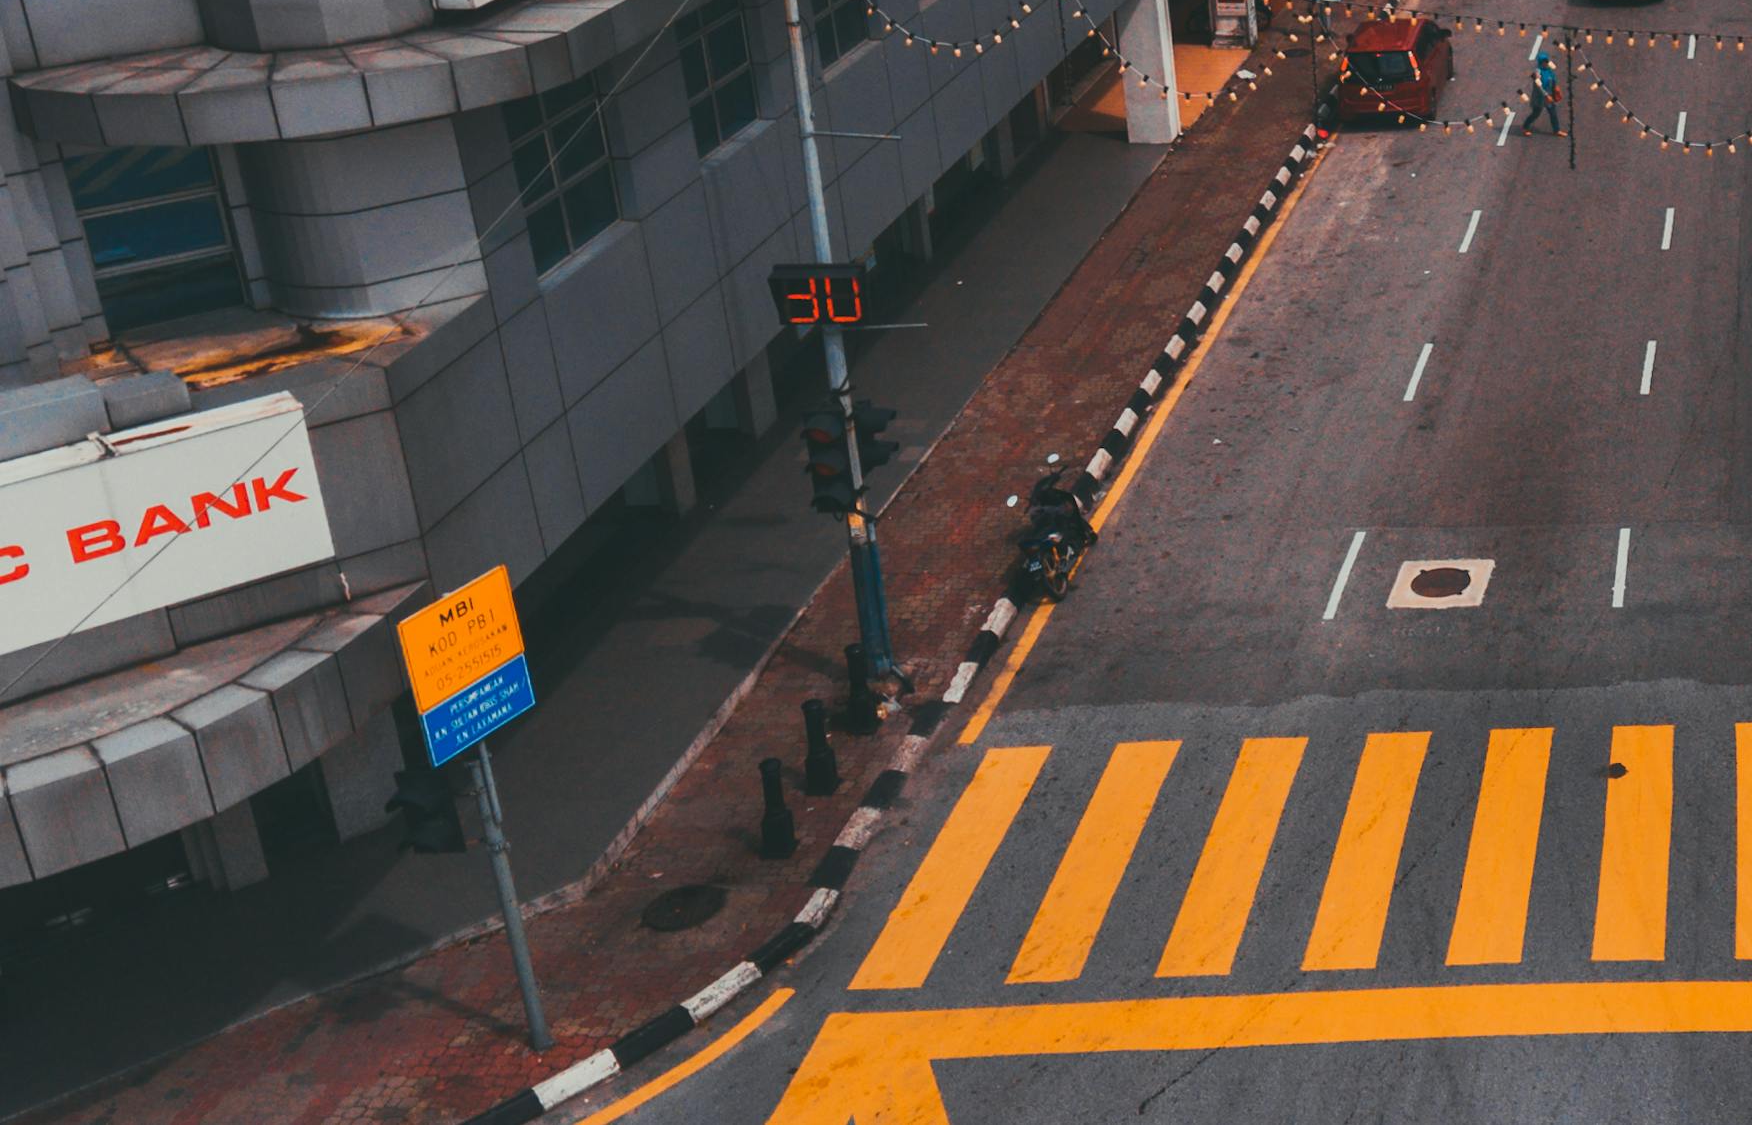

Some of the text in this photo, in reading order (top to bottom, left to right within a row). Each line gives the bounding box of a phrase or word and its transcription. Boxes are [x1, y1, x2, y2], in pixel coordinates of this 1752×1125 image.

[787, 277, 862, 324] 30
[66, 467, 309, 564] BANK
[439, 598, 474, 627] MBI
[428, 631, 457, 658] KOD
[436, 646, 502, 691] 05-2551515
